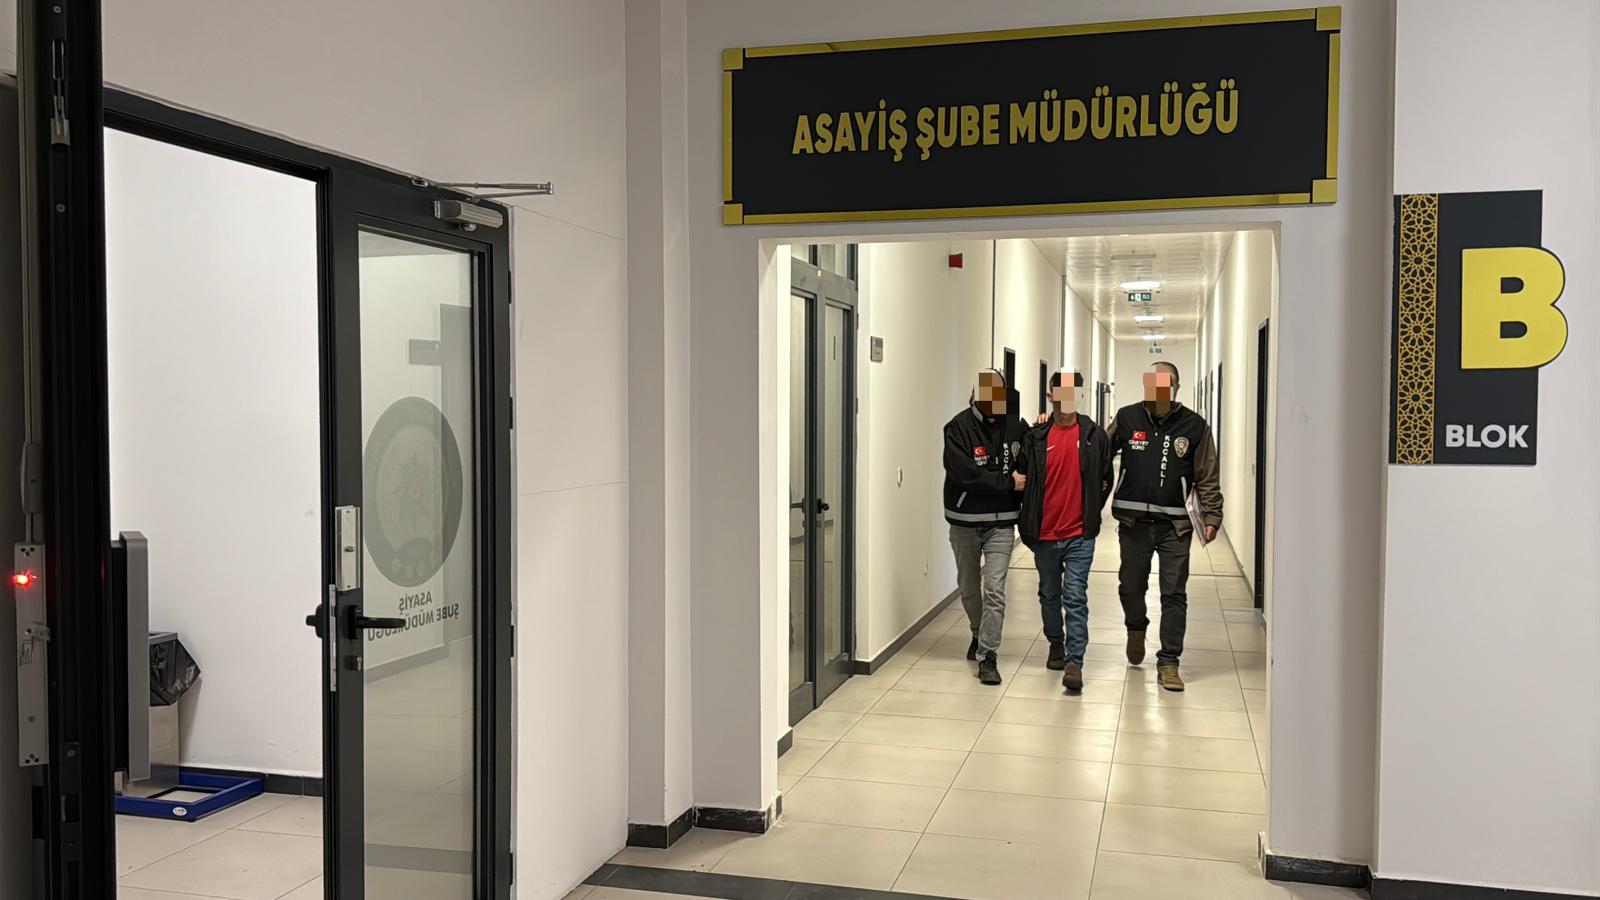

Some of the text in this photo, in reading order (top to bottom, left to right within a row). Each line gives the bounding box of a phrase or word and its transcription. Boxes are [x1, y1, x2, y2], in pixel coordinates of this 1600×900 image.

[792, 78, 1239, 162] ASAYİŞ ŞUBE MÜDÜRLÜĞÜ
[1461, 247, 1568, 369] B
[1445, 424, 1529, 448] BLOK
